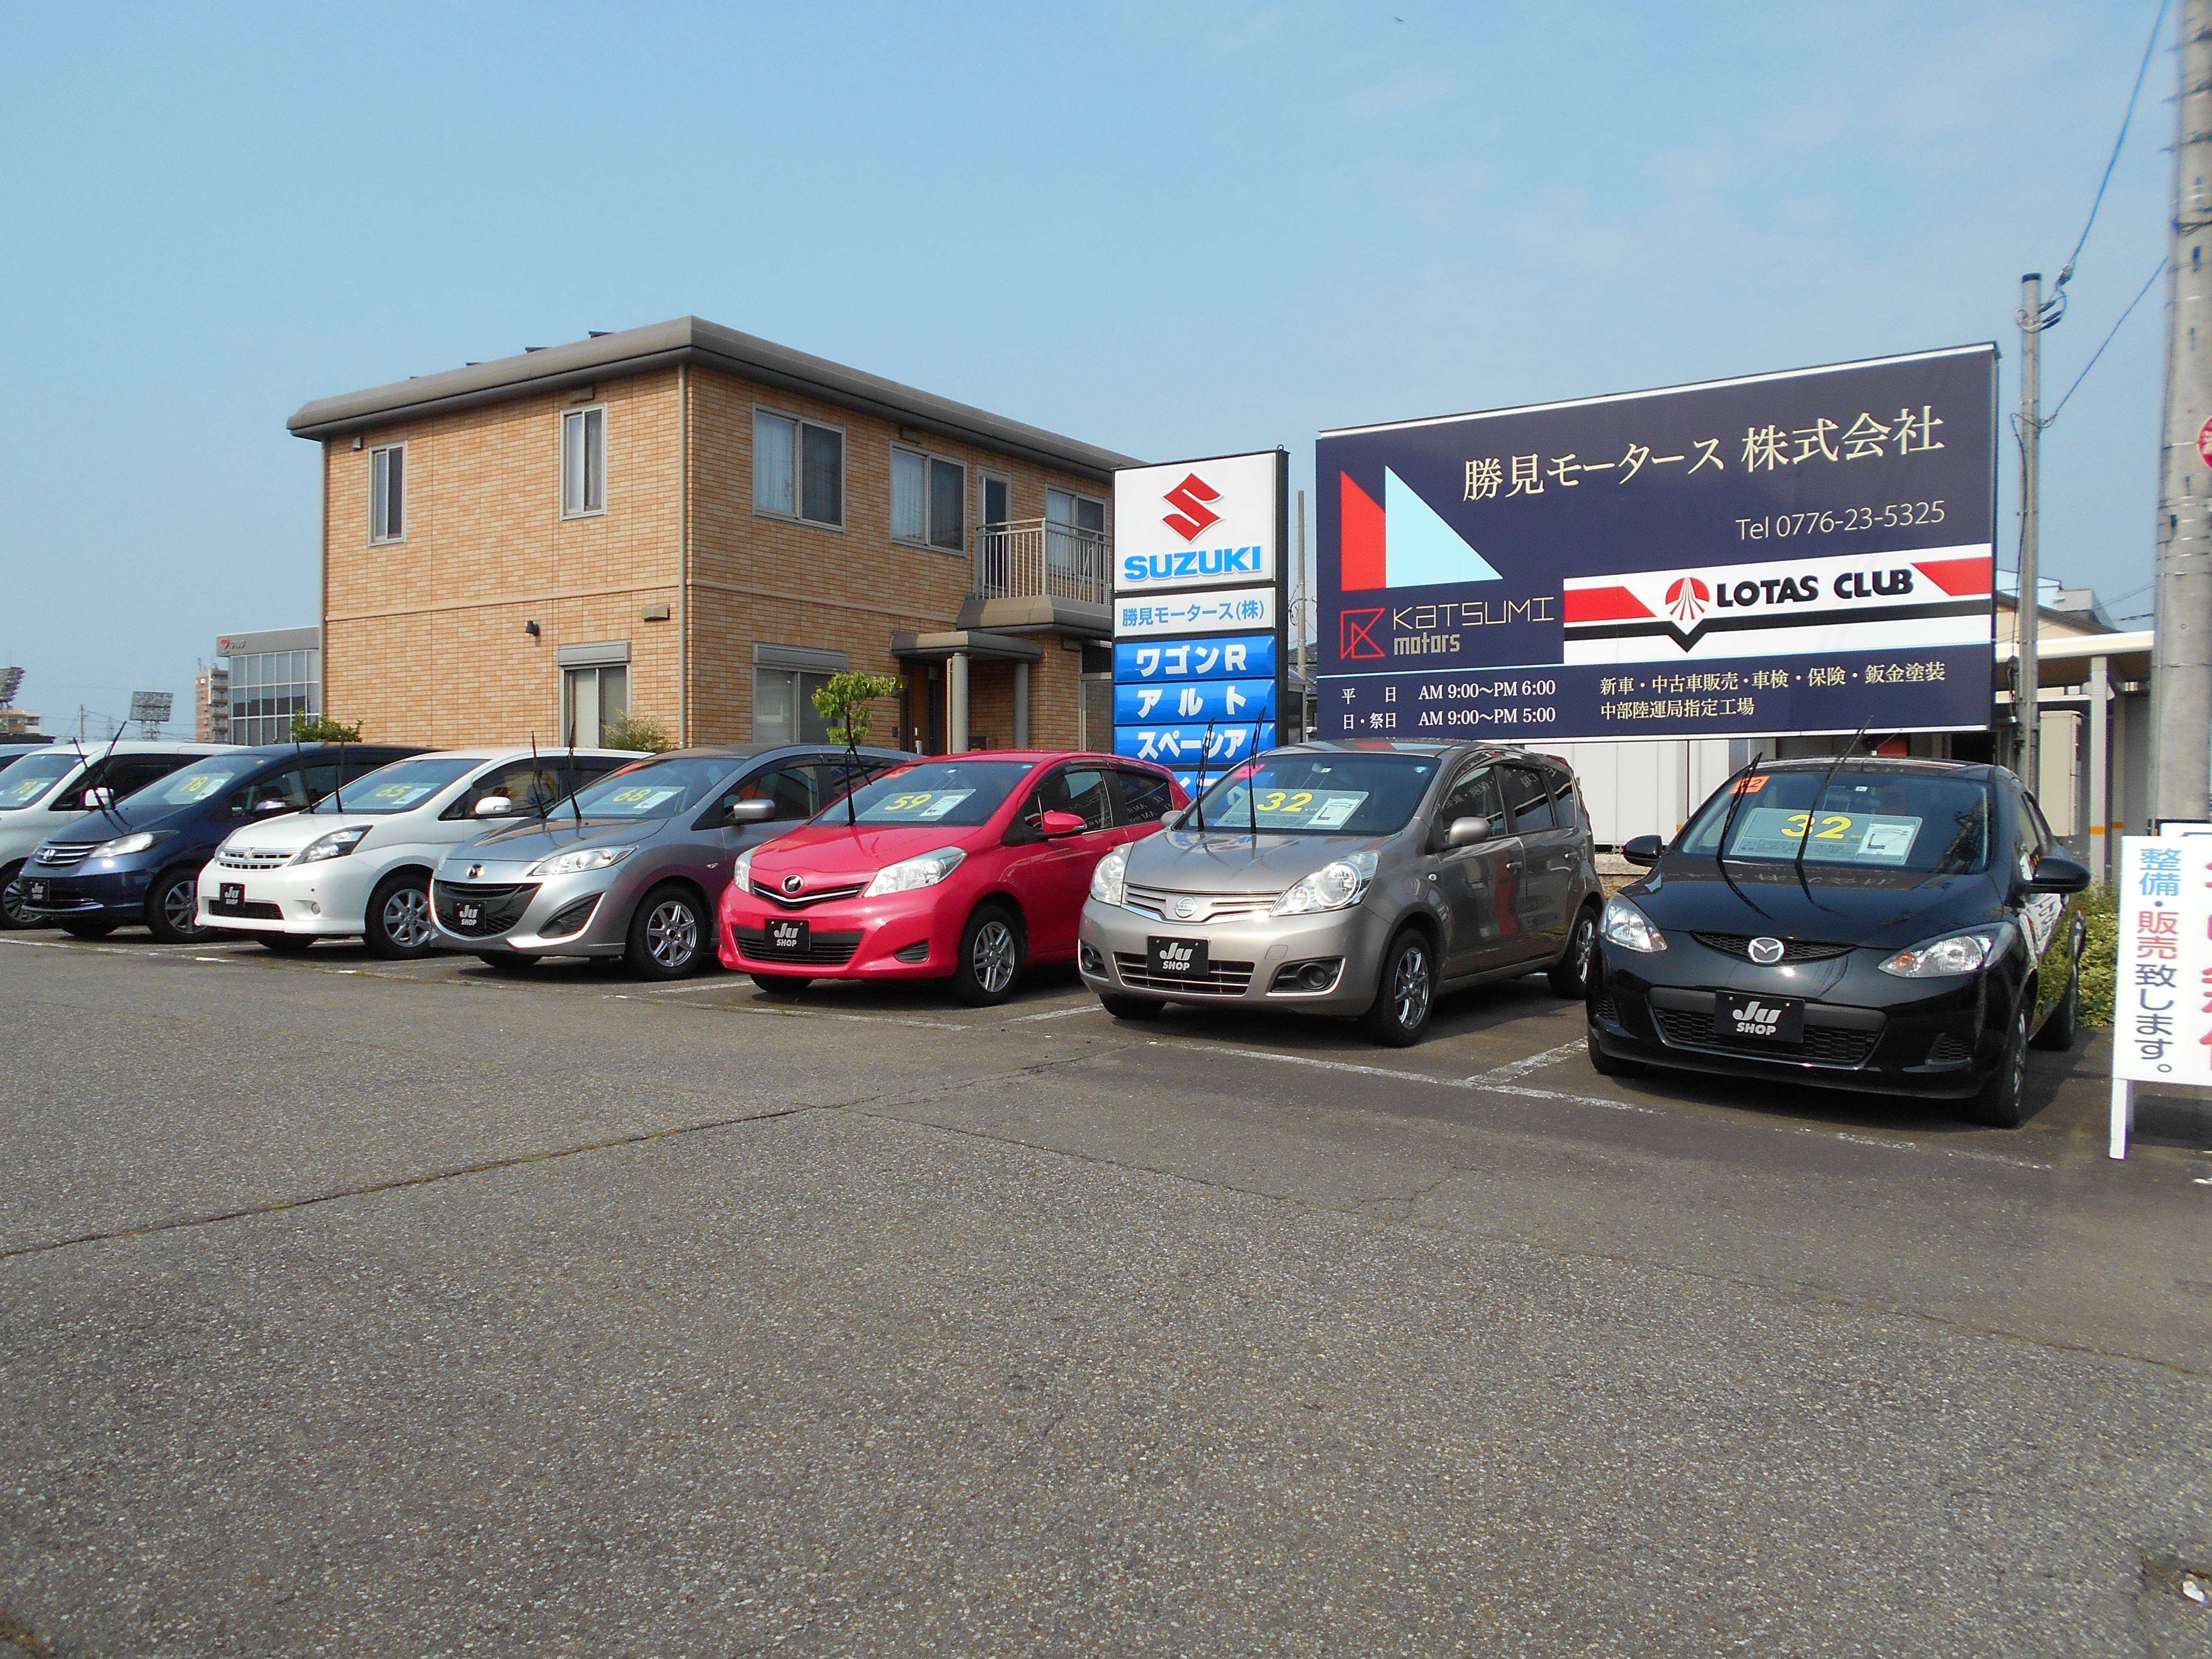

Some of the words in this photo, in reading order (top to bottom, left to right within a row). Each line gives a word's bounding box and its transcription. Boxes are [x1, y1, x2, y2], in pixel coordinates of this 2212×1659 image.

[1462, 438, 1724, 502] 勝見モータース
[1741, 405, 1946, 473] 株式会社
[1735, 516, 1769, 540] Tel
[1776, 500, 1945, 538] 0776-23-5325
[1124, 545, 1262, 582] SUZUKI
[1716, 575, 1819, 608] LOTAS
[1833, 568, 1914, 599] CLUB
[1122, 599, 1265, 627] 勝見モータース(株)
[1393, 632, 1460, 656] motors
[1136, 644, 1247, 678] ワゴンR
[1137, 685, 1247, 719] アルト
[1418, 685, 1443, 700] AM
[1521, 679, 1556, 696] 6:00
[1343, 711, 1397, 730] 日・祭日
[1418, 711, 1443, 726] AM
[1522, 707, 1556, 723] 5:00
[1600, 696, 1755, 720] 中部陸運局指定工場
[1137, 729, 1247, 760] スペーシア
[179, 776, 209, 792] 78
[613, 788, 652, 802] 68
[884, 793, 932, 811] 59
[1780, 814, 1853, 840] 32
[776, 939, 797, 947] SHOP
[1162, 960, 1190, 971] SHOP
[2134, 848, 2182, 1073] 整備・販売致します。
[1736, 1022, 1776, 1035] SHOP
